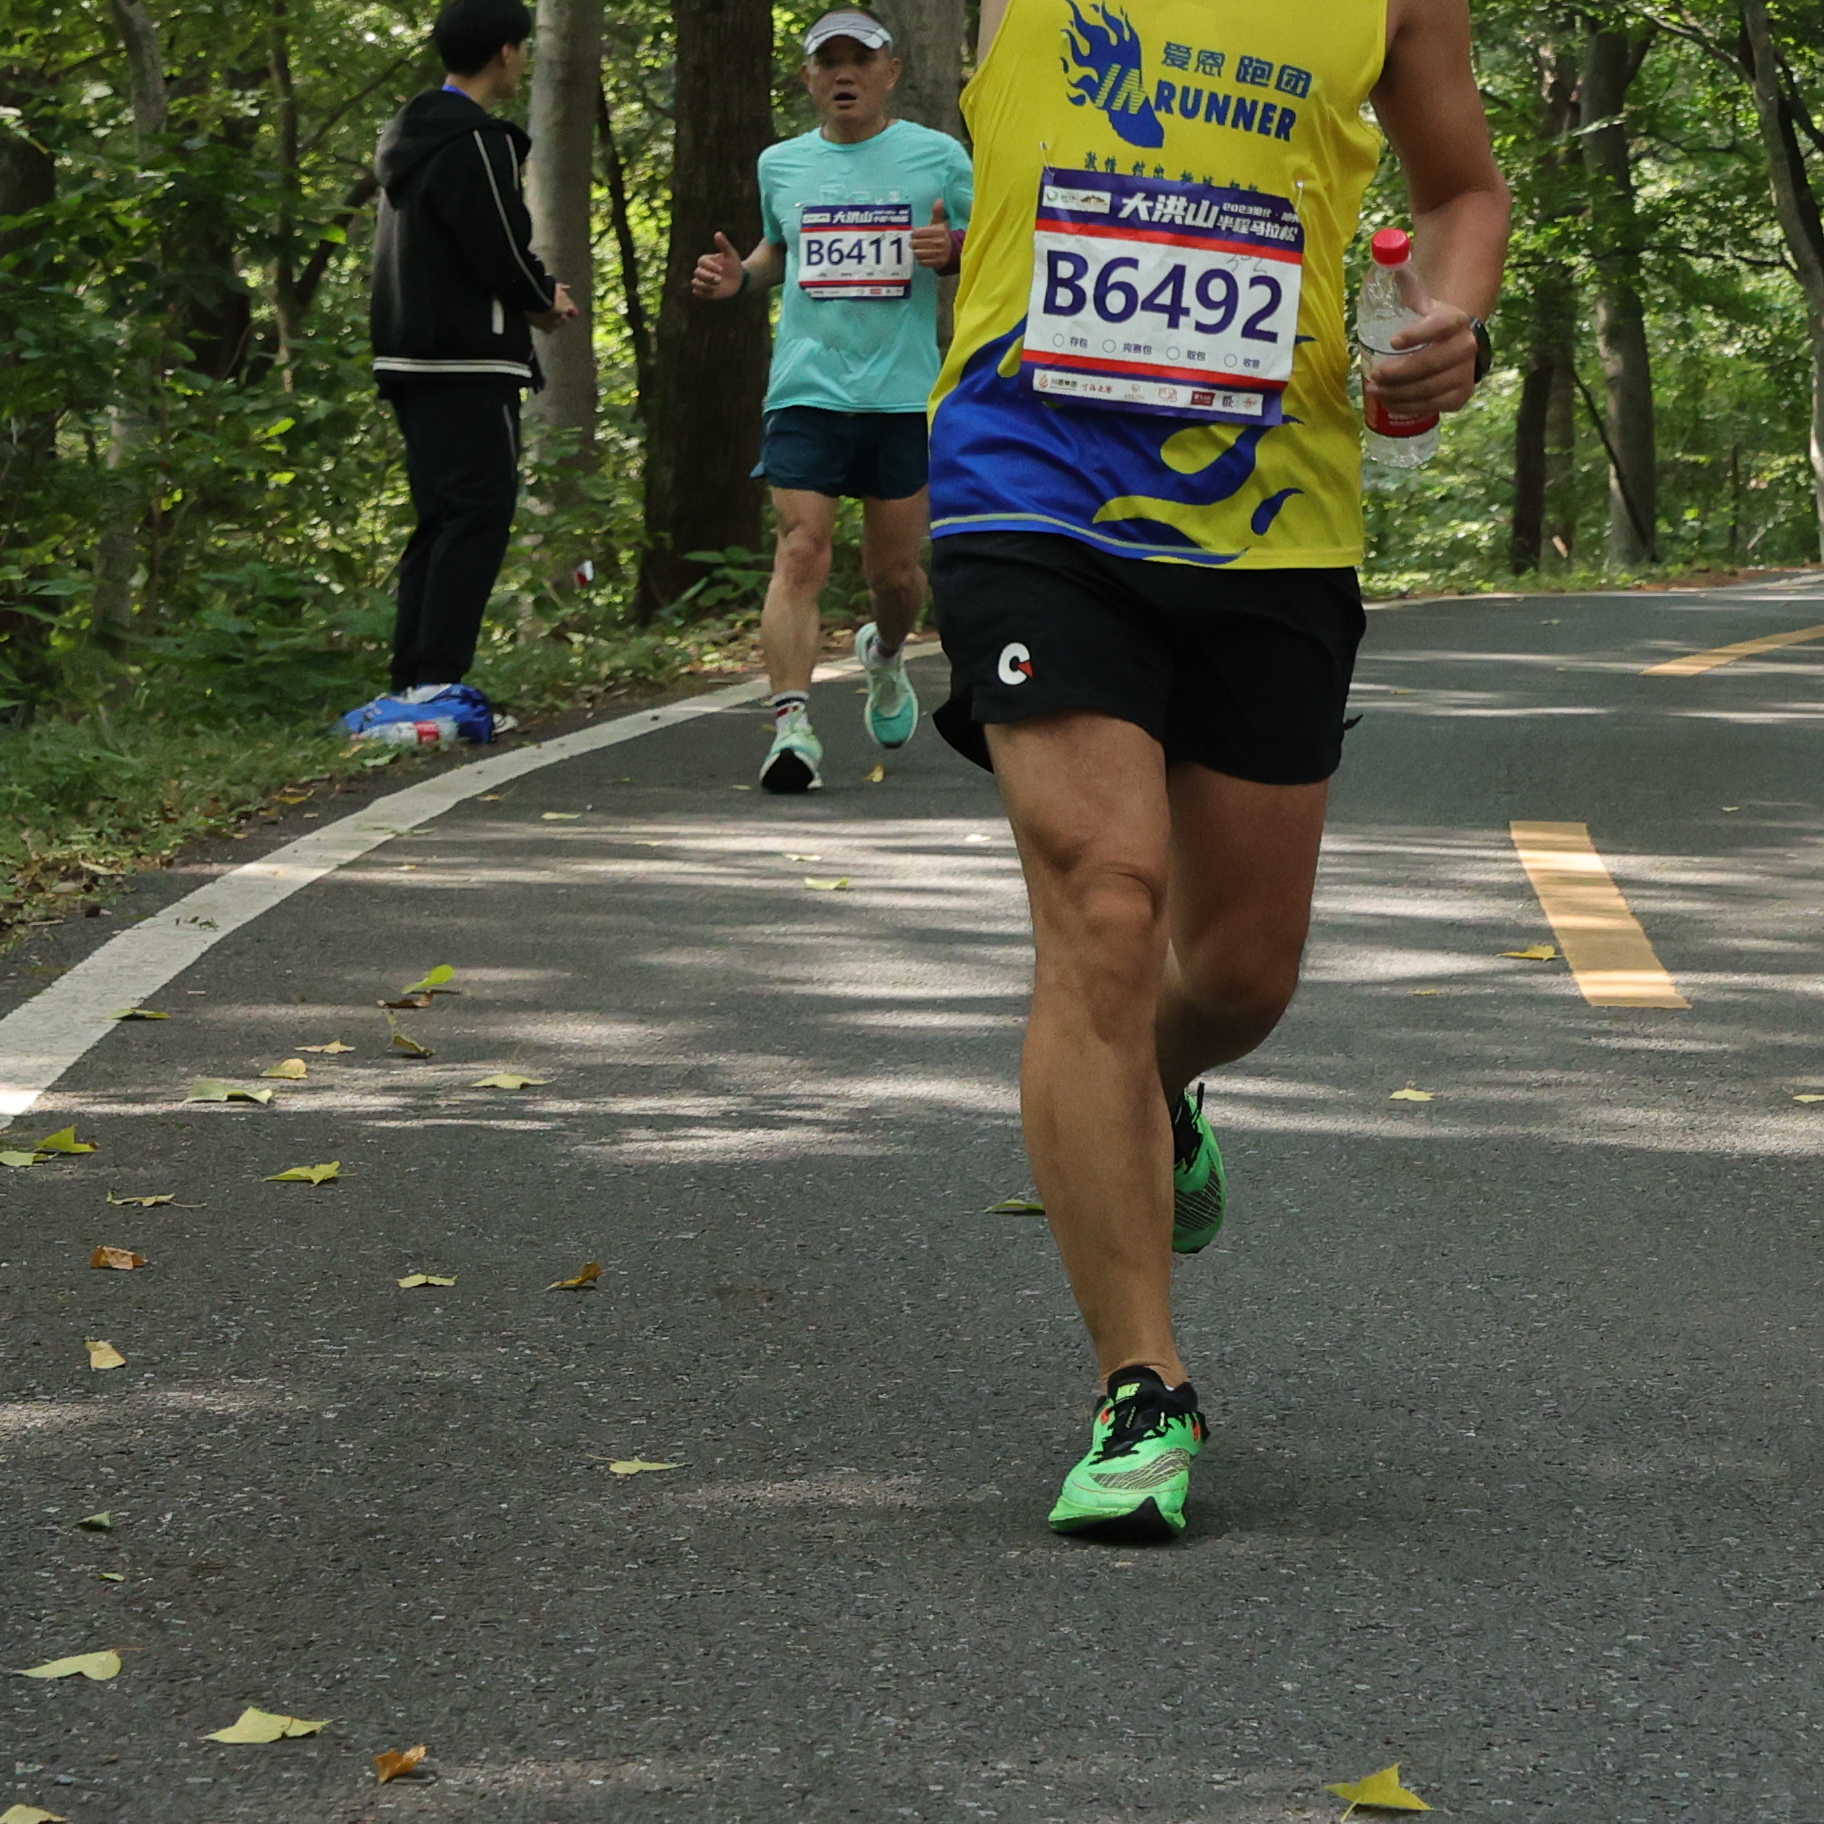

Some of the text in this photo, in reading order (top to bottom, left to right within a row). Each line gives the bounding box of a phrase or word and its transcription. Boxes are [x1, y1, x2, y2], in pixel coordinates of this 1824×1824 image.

[1161, 41, 1313, 99] 爱恩 跑团
[1154, 79, 1298, 142] RUNNER
[1118, 191, 1220, 229] 大洪山
[805, 237, 903, 266] B6411
[1042, 249, 1283, 344] B6492
